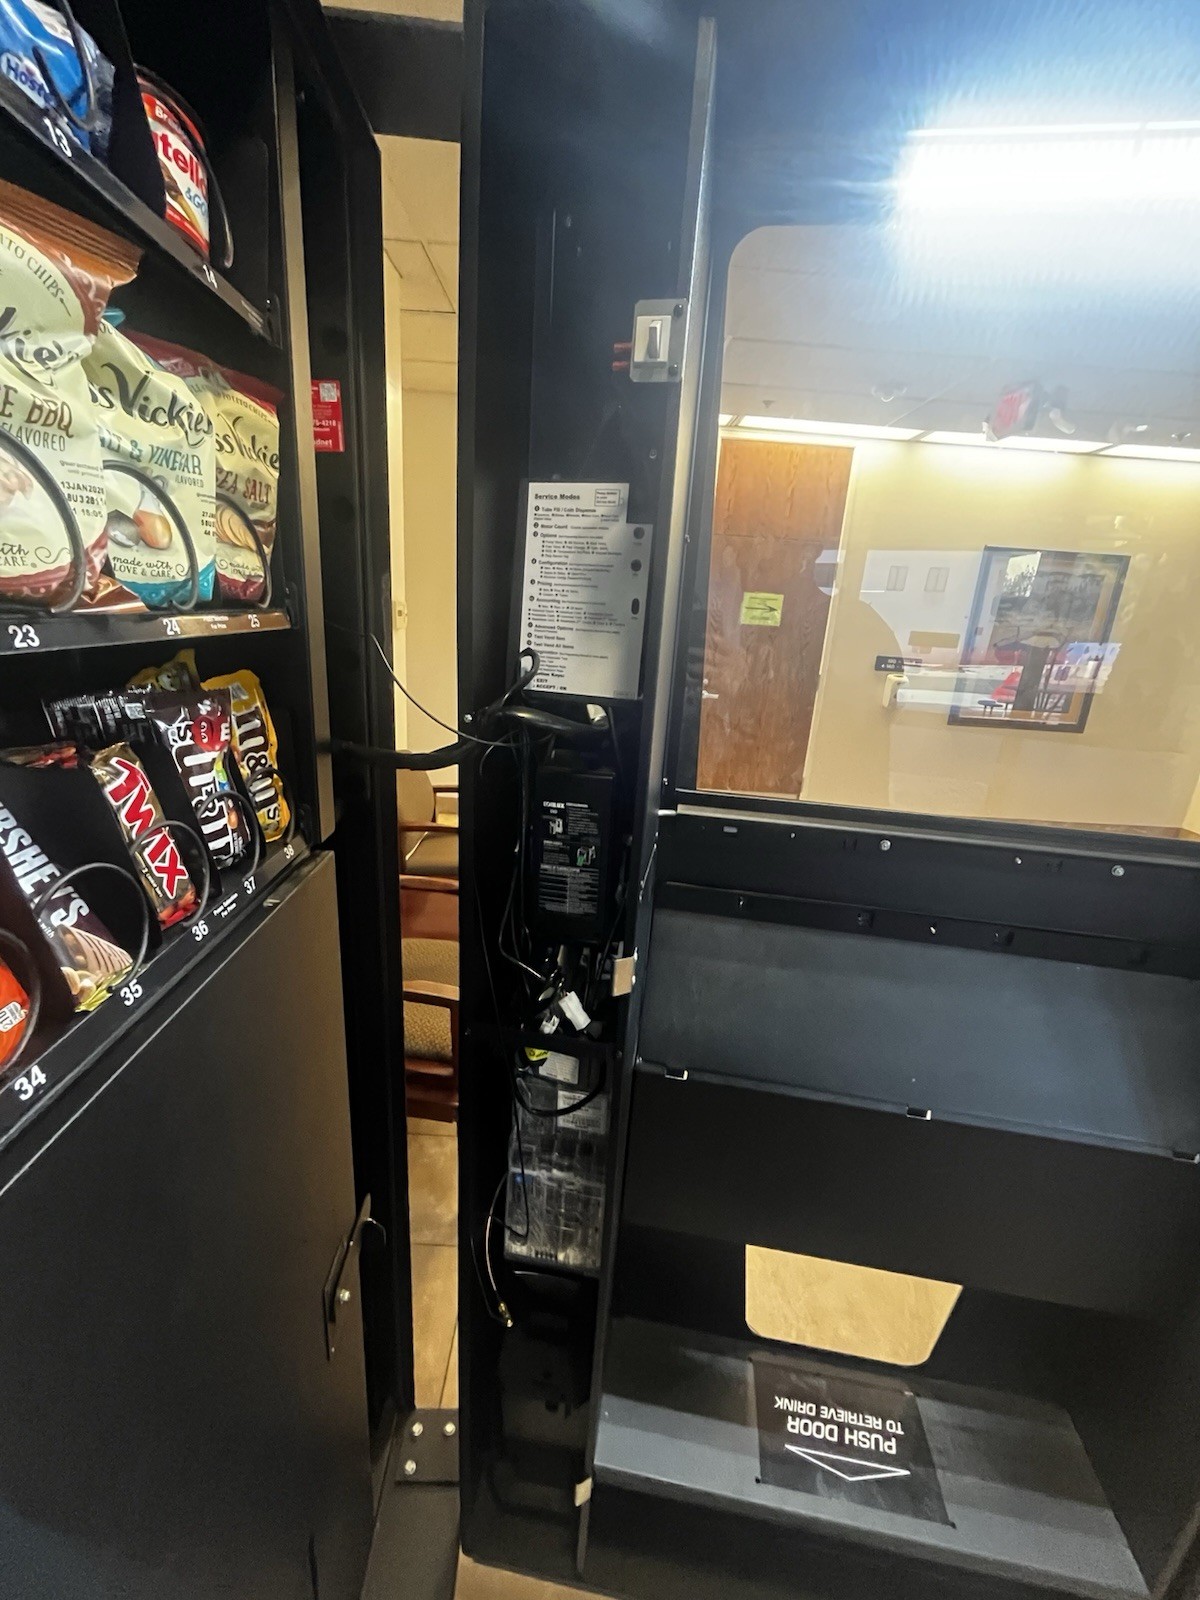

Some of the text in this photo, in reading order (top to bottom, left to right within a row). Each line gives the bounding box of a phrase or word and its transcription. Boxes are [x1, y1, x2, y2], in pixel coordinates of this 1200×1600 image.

[42, 117, 72, 157] 13
[27, 256, 65, 300] CHIPS
[203, 264, 218, 289] 14
[24, 393, 74, 439] BBQ
[100, 362, 215, 448] Vickies
[243, 477, 272, 503] SALT
[534, 493, 558, 501] Service
[112, 556, 173, 570] made with
[113, 563, 138, 576] LOVE
[150, 569, 171, 578] CARE
[162, 618, 181, 636] 24
[247, 613, 260, 628] 25
[8, 624, 40, 648] 23
[106, 756, 189, 899] TWIX
[283, 844, 294, 859] 38
[243, 875, 256, 895] 37
[191, 919, 209, 942] 36
[120, 978, 143, 1007] 35
[14, 1064, 47, 1101] 34
[773, 1395, 905, 1435] TO RETRIEVE DRINK
[786, 1415, 897, 1455] PUSH DOOR
